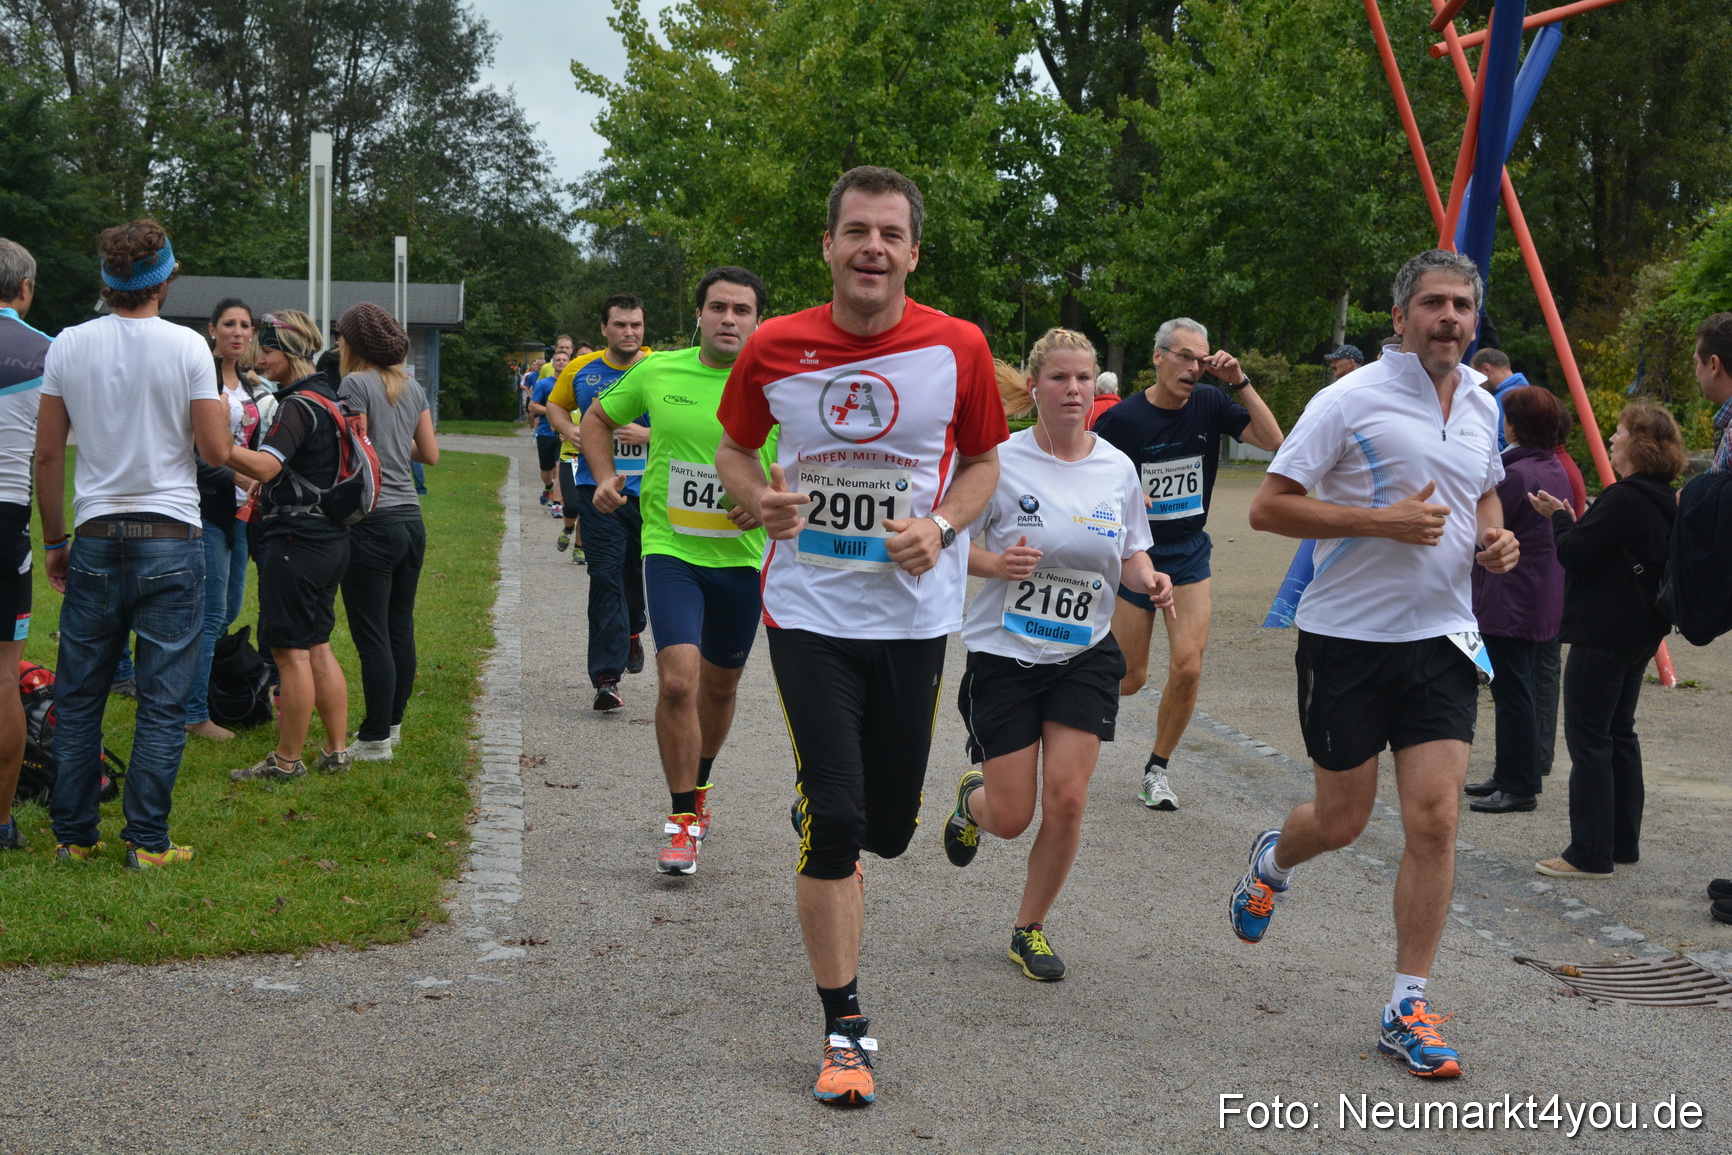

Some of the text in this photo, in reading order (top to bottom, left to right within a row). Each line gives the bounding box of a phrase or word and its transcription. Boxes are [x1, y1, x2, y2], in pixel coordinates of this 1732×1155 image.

[798, 451, 919, 467] LAUFEN MIT HERZ
[671, 466, 695, 477] PARTL
[1166, 464, 1193, 473] Neumarkt
[801, 472, 891, 489] PARTL Neumarkt
[1149, 471, 1198, 498] 2276
[808, 490, 895, 532] 2901
[1160, 502, 1188, 512] Werner
[833, 539, 867, 556] Willi
[1046, 573, 1089, 588] Neumarkt
[1015, 581, 1093, 621] 2168
[1025, 621, 1070, 640] Claudia
